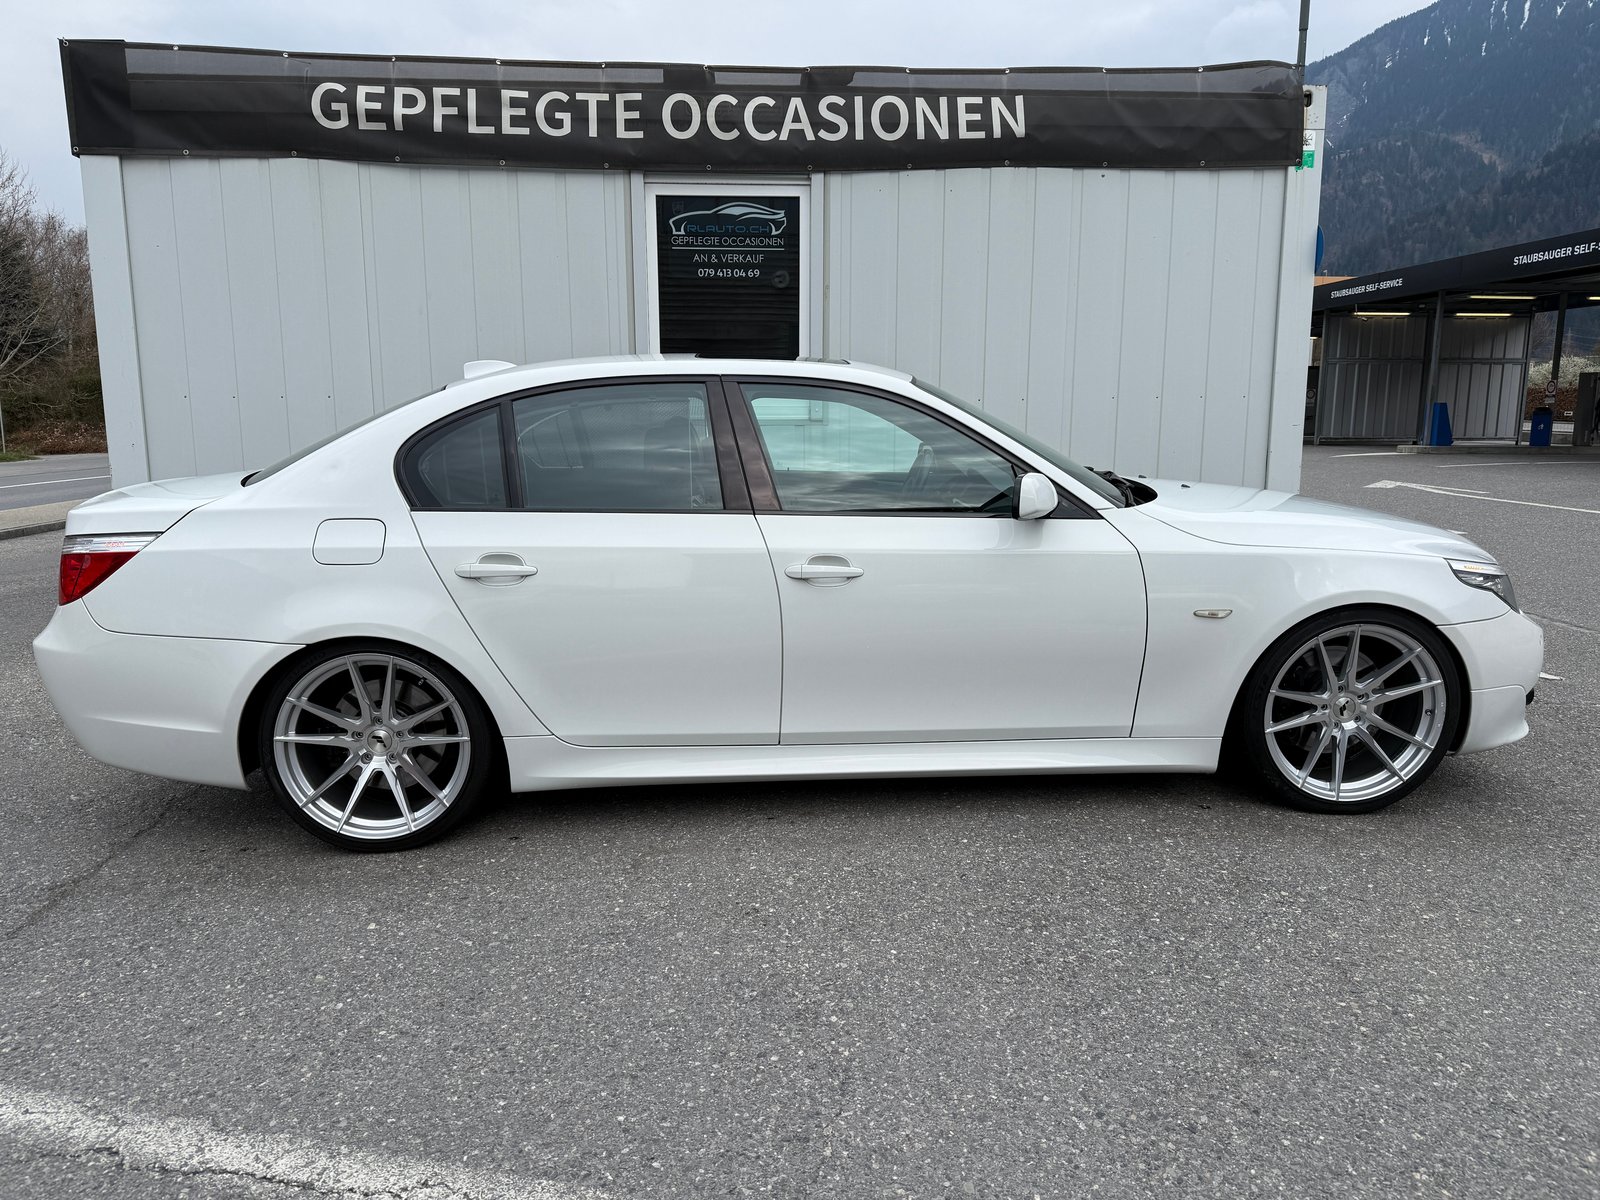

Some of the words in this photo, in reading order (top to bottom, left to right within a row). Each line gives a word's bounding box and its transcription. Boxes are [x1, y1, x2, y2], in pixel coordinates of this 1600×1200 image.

[309, 80, 645, 140] GEPFLEGTE
[661, 91, 1027, 142] OCCASIONEN
[686, 224, 770, 234] RLAUTO.CH
[671, 236, 720, 246] GEPFLEGTE
[722, 236, 785, 246] OCCASIONEN
[693, 253, 708, 263] AN
[711, 254, 718, 263] &
[720, 253, 765, 263] VERKAUF
[1513, 246, 1572, 266] STAUBSAUGER
[1573, 241, 1600, 255] SELF-
[698, 268, 715, 278] 079
[716, 268, 732, 278] 413
[733, 268, 746, 278] 04
[748, 268, 760, 278] 69
[1330, 285, 1366, 299] STAUBSAUGER
[1365, 278, 1403, 292] SELF-SERVICE
